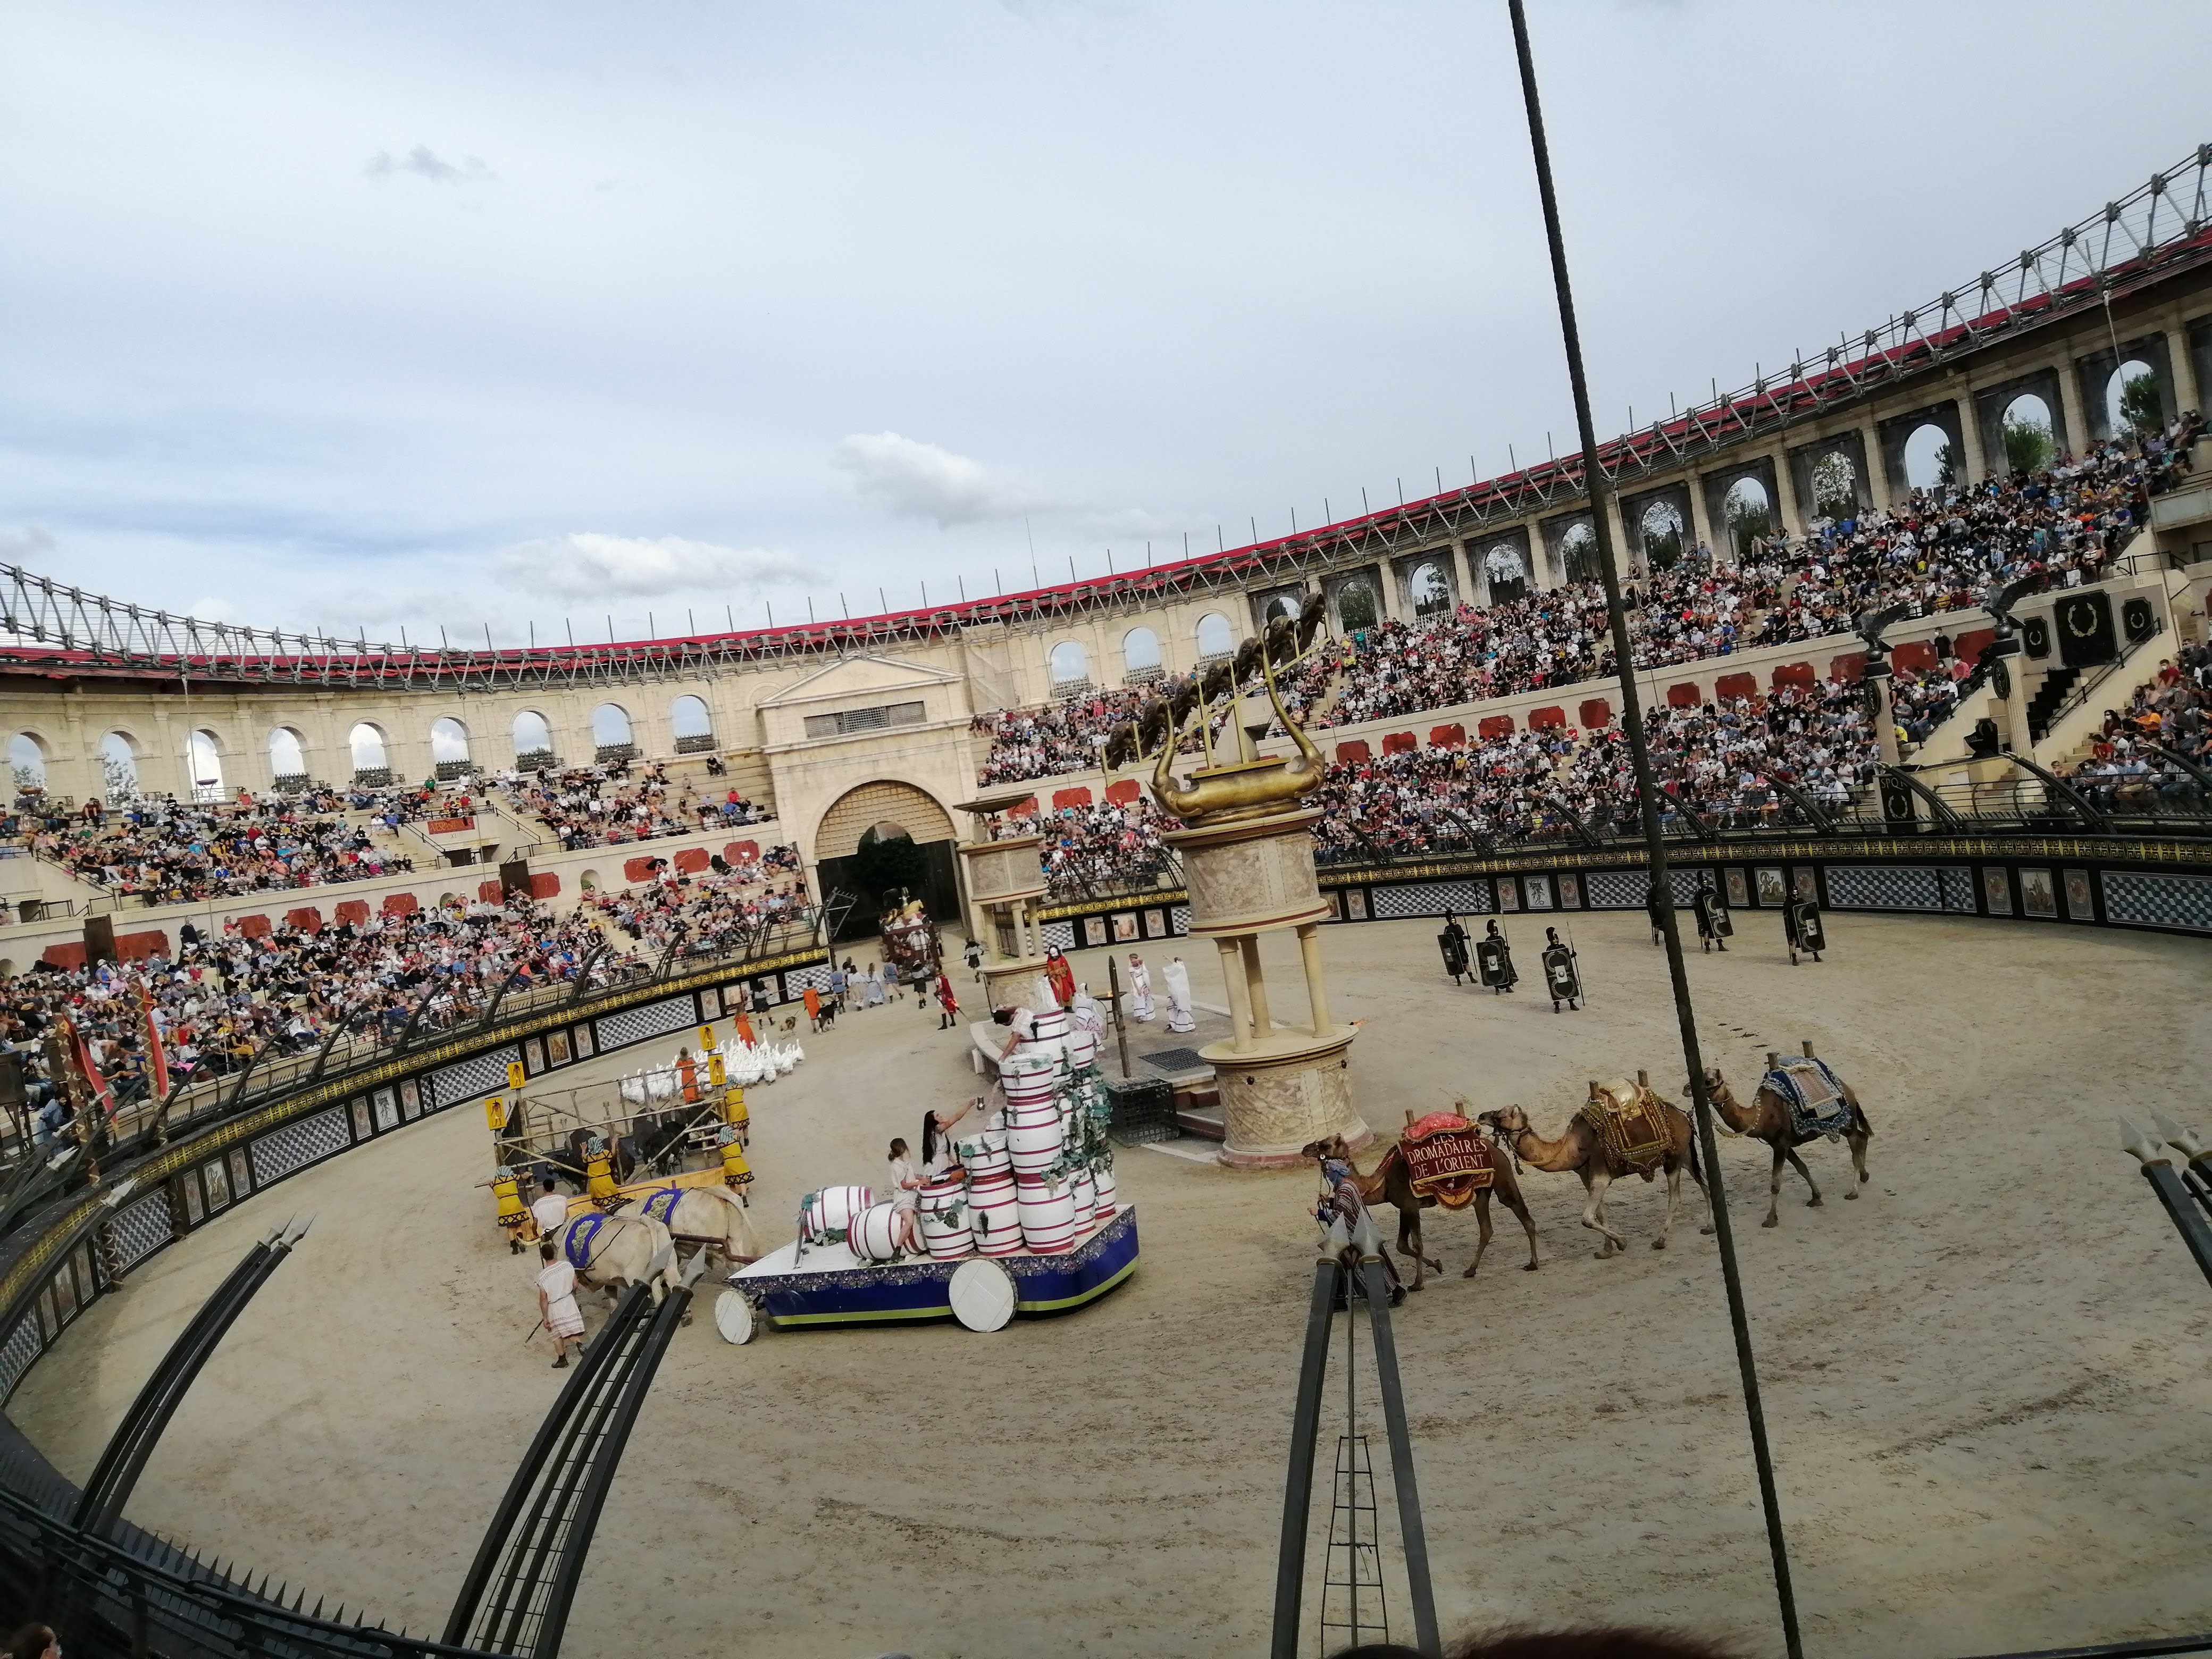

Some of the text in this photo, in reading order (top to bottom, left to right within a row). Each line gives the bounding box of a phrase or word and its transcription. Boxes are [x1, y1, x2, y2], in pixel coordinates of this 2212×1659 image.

[1407, 1138, 1487, 1164] DROMADAIRES
[1432, 1134, 1455, 1145] LES
[1414, 1154, 1484, 1179] DE L'ORIENT
